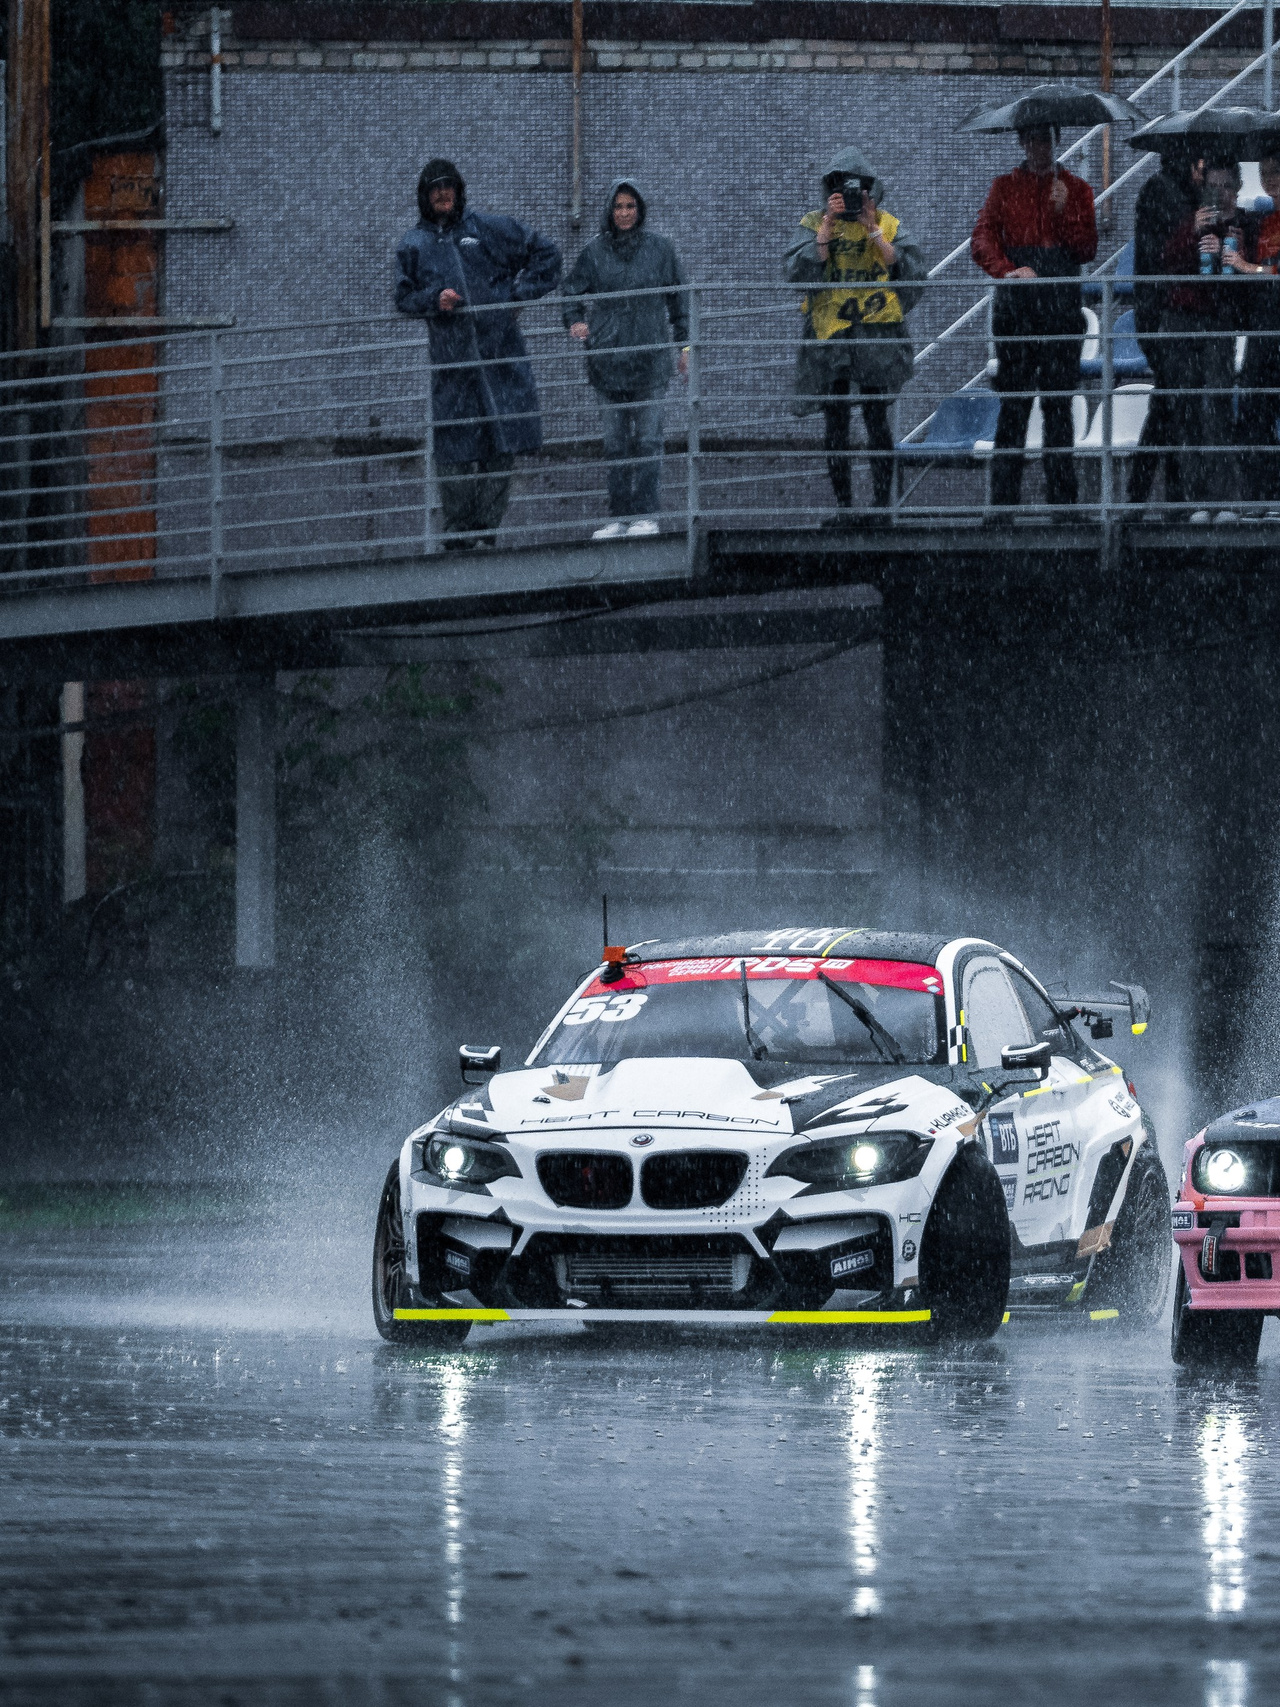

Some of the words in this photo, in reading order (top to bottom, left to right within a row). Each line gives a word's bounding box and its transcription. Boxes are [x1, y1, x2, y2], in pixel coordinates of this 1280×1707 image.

[721, 957, 827, 973] RDS
[563, 994, 648, 1025] 53
[520, 1110, 620, 1125] HEAT
[633, 1110, 780, 1126] CARBON
[999, 1123, 1017, 1152] ВТБ
[1025, 1120, 1060, 1149] HEAT
[1027, 1141, 1081, 1174] CARBON
[899, 1213, 921, 1222] HC
